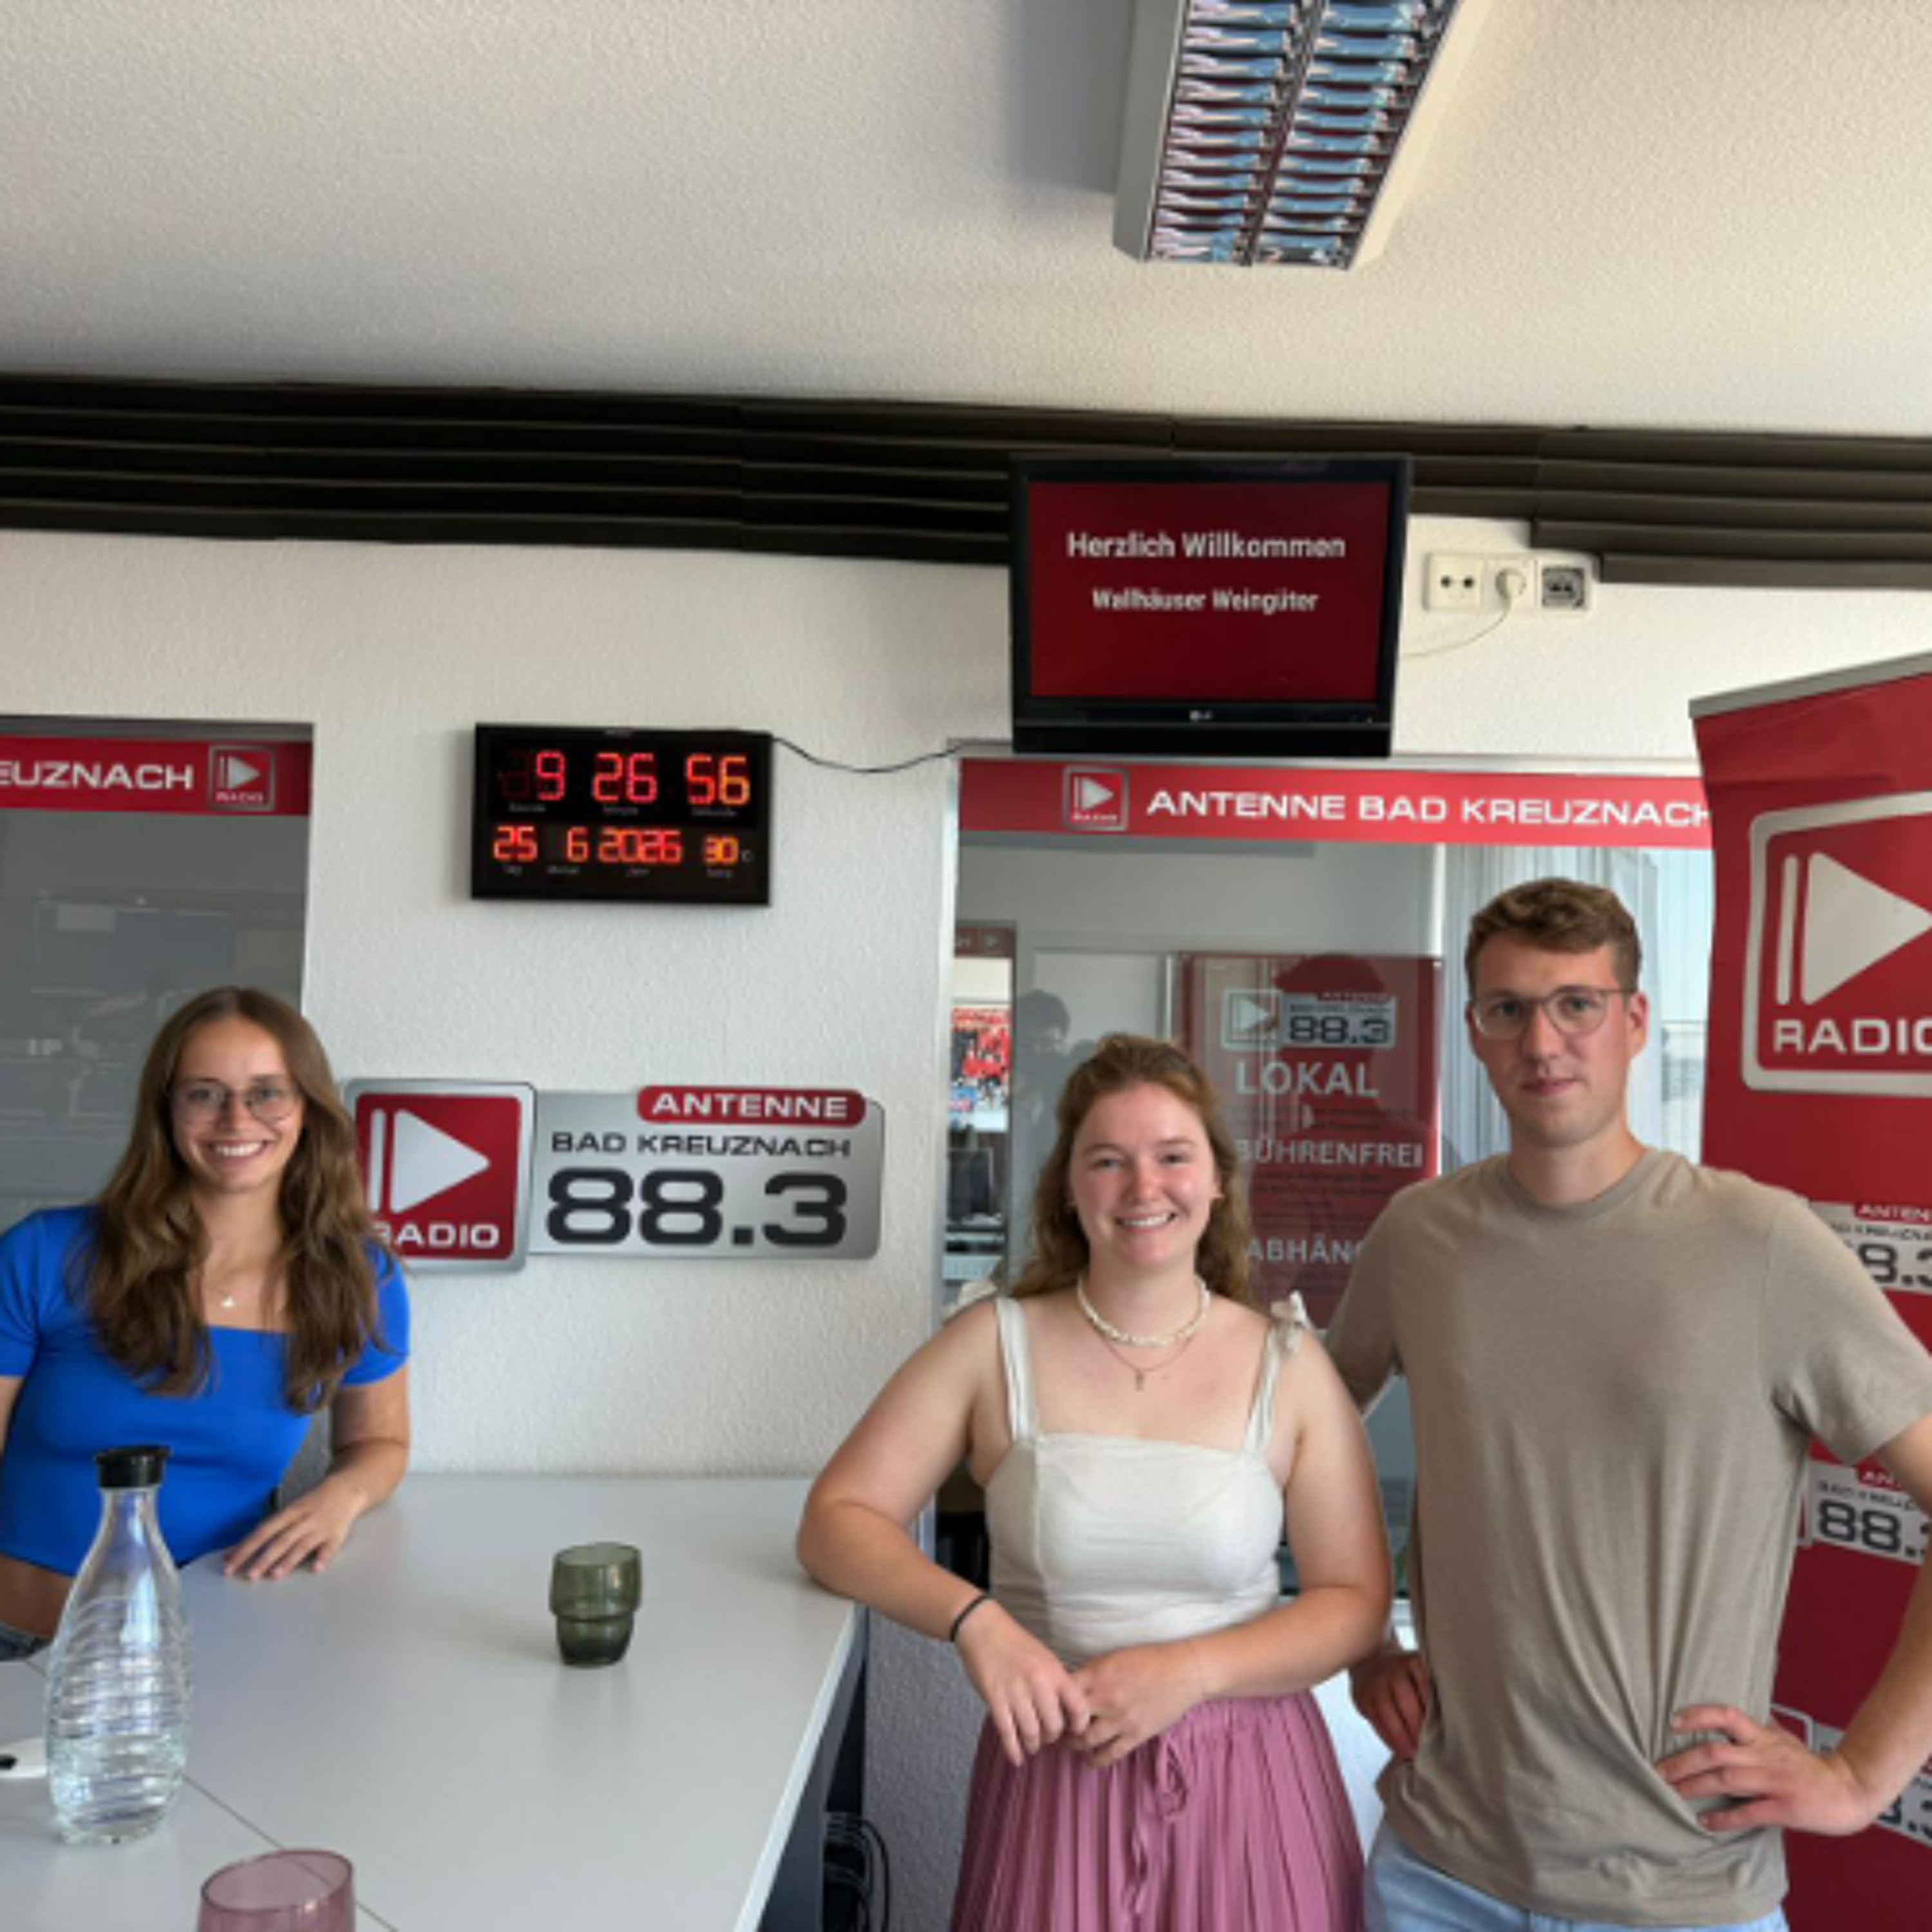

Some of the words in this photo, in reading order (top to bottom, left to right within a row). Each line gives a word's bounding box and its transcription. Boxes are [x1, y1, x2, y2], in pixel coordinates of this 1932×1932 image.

[1066, 531, 1176, 558] Herzlich
[1182, 531, 1346, 558] Willkommen
[1212, 587, 1320, 615] Weingüter
[536, 750, 565, 801] 9
[593, 752, 658, 804] 26
[687, 754, 751, 806] 56
[1146, 790, 1345, 820] ANTENNE
[1358, 796, 1447, 821] BAD
[494, 826, 537, 861] 25
[567, 826, 589, 862] 6
[598, 826, 682, 864] 2026
[1290, 1015, 1388, 1045] 88.3
[1236, 1061, 1379, 1097] LOKAL
[652, 1093, 849, 1118] ANTENNE
[553, 1132, 627, 1154] BAD
[638, 1135, 851, 1157] KREUZNACH
[546, 1168, 849, 1247] 88.3
[1818, 1499, 1931, 1556] 88.
